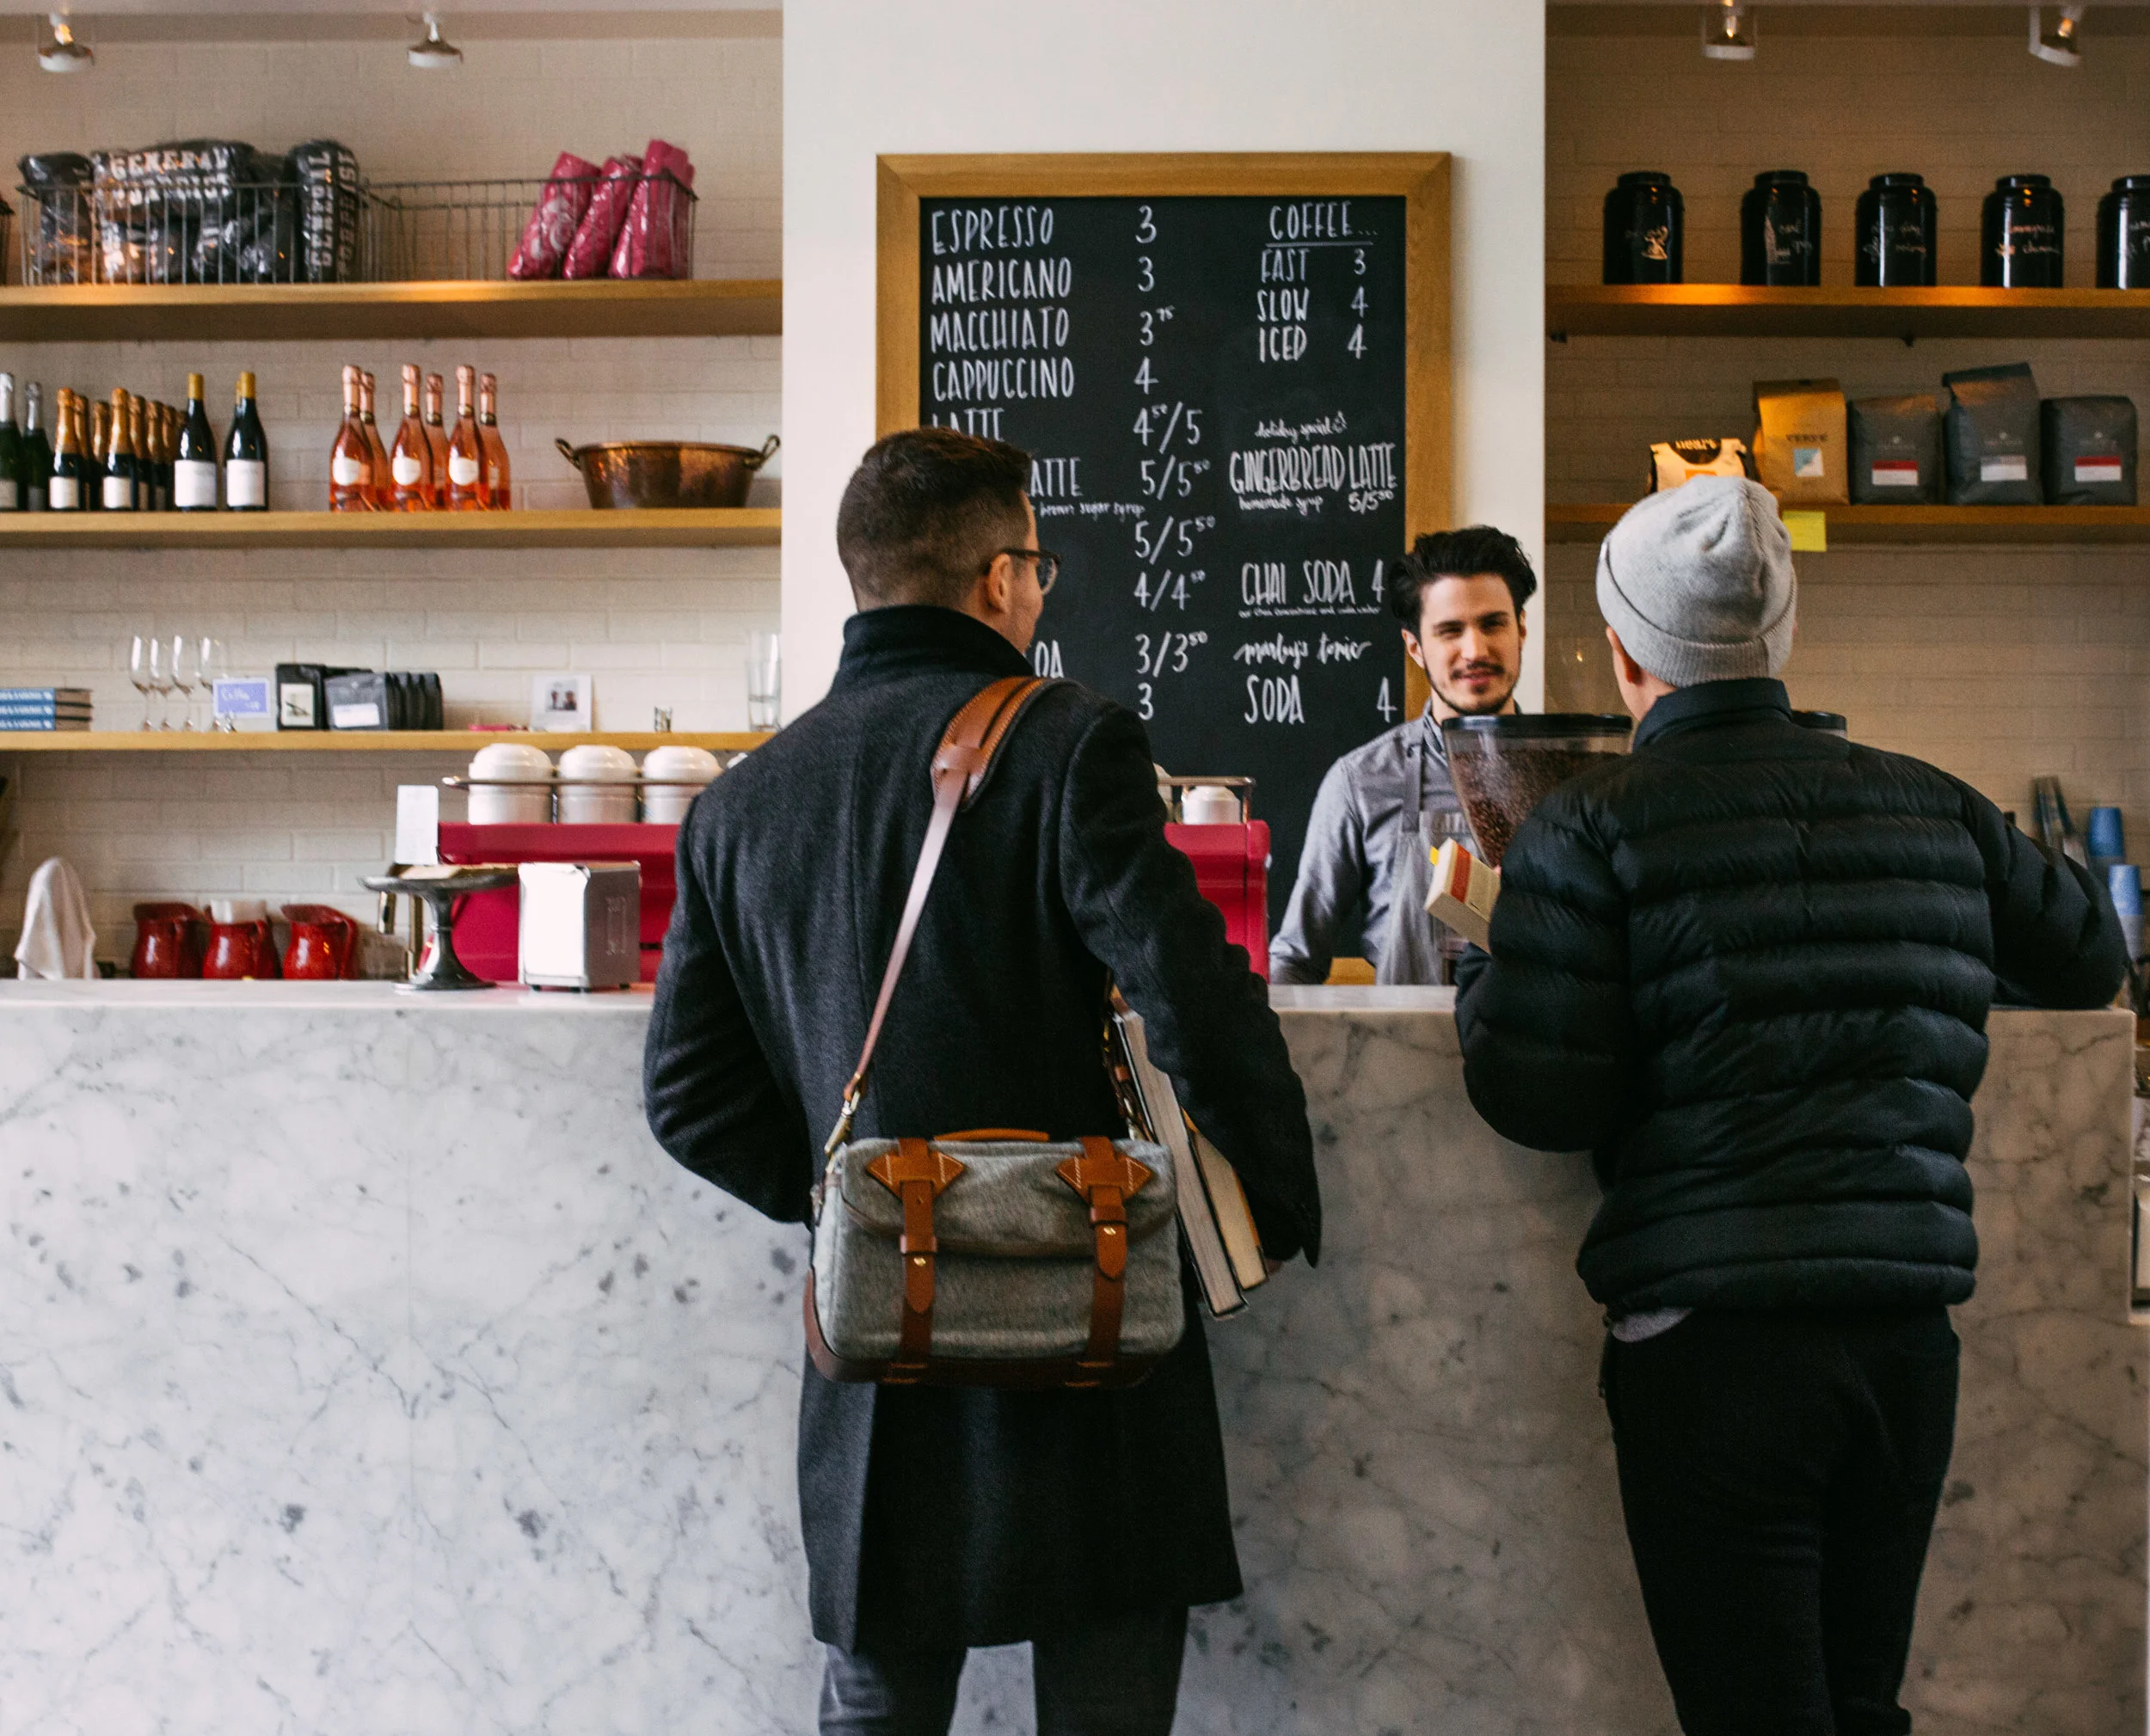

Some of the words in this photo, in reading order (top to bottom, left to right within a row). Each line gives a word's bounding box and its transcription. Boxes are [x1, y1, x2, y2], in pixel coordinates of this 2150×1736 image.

[931, 205, 1054, 255] ESPRESSO
[1135, 205, 1158, 244] 3
[931, 256, 1072, 305] AMERICANO
[1138, 255, 1155, 292] 3
[1261, 245, 1309, 284] FAST
[1354, 248, 1367, 275] 3
[1256, 287, 1310, 322] SLOW
[1351, 285, 1368, 317] 4
[931, 305, 1070, 353] MACCHIATO
[1259, 324, 1308, 364] ICED
[1347, 323, 1367, 359] 4
[932, 356, 1075, 402] CAPPUCCINO
[1133, 356, 1159, 395] 4
[1030, 457, 1085, 497] ATTE
[1229, 445, 1346, 494] GINGERBREAD
[1348, 442, 1398, 490] LATTE
[1240, 561, 1288, 606] CHAI
[1301, 559, 1358, 604] SODA
[1371, 559, 1385, 603] 4
[1137, 682, 1154, 721] 3
[1244, 673, 1305, 725] SODA
[1376, 677, 1398, 723] 4
